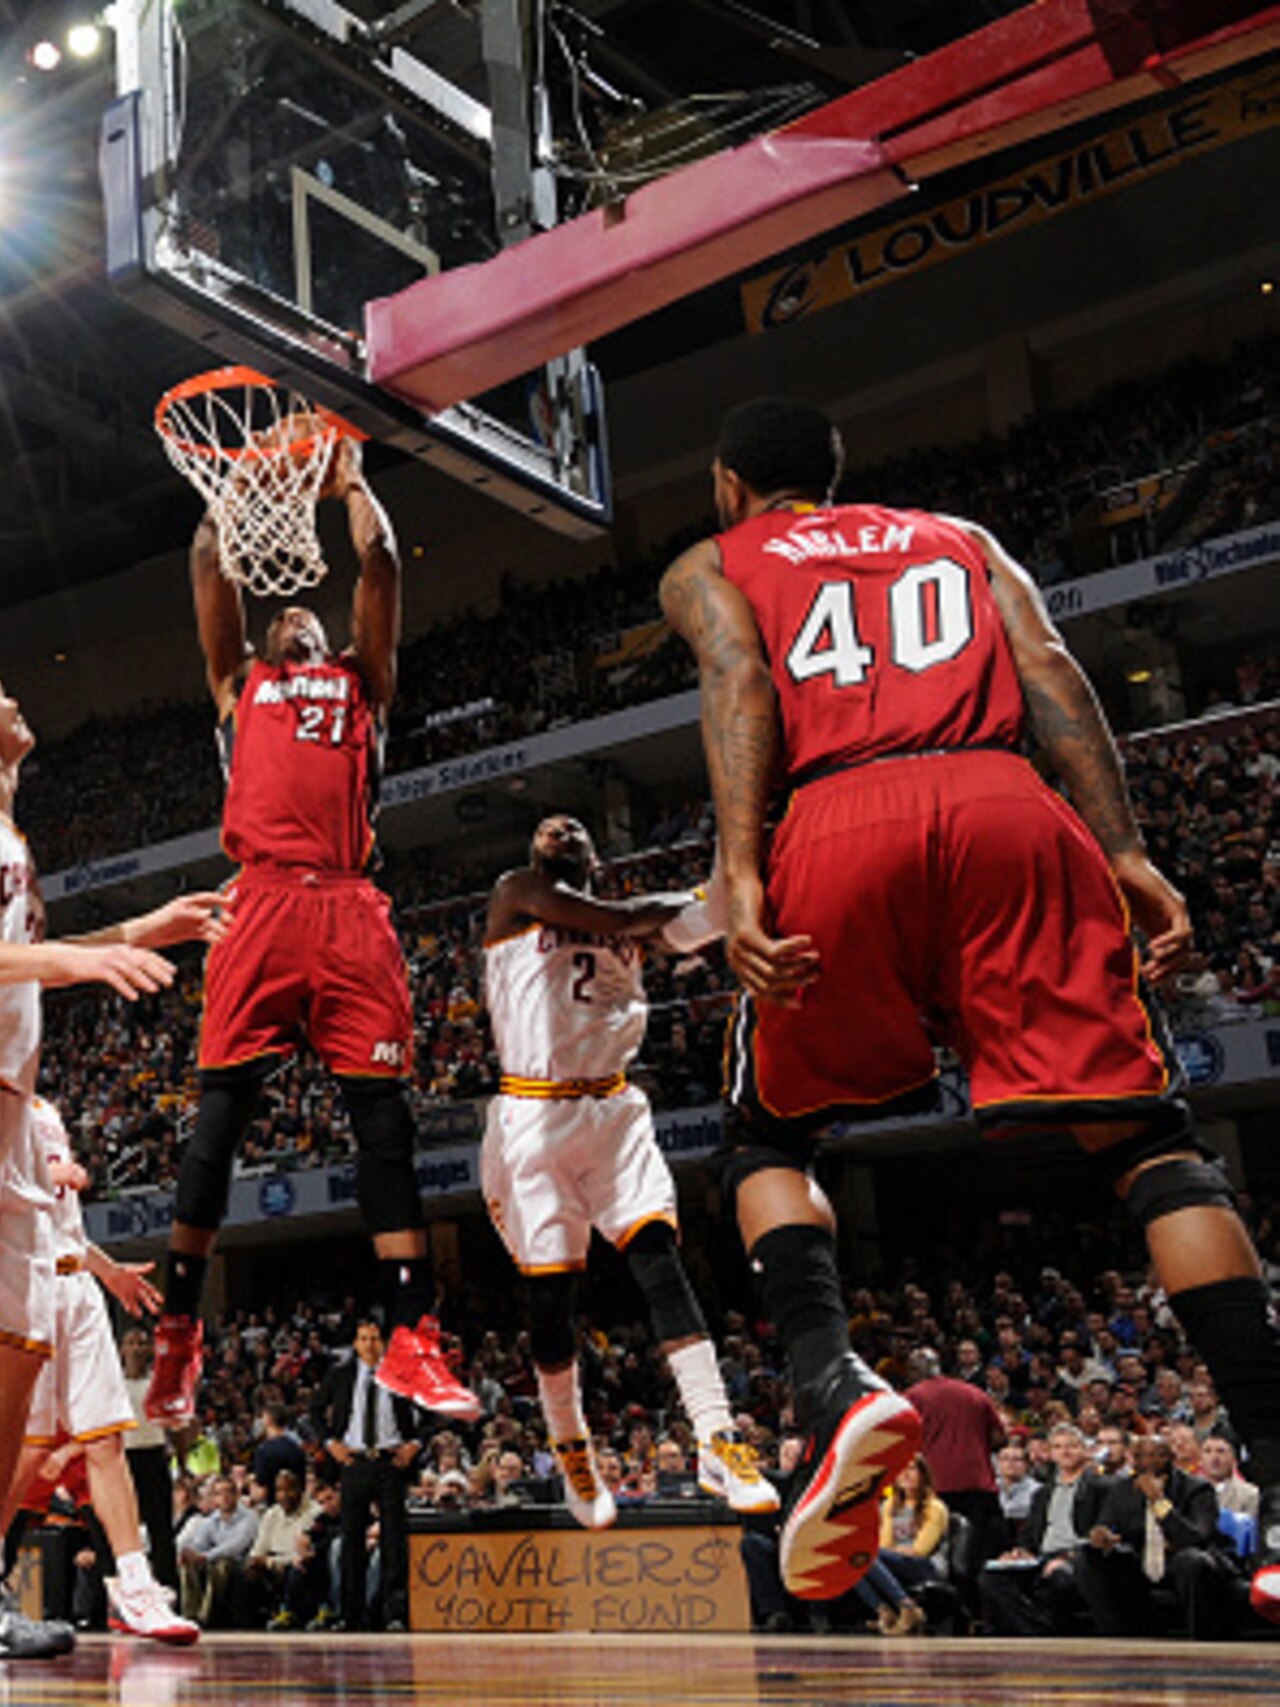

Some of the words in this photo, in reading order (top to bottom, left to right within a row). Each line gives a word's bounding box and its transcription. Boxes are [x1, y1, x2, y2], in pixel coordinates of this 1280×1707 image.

[848, 105, 1218, 287] LOUDVILLE
[786, 556, 976, 689] 40
[296, 705, 345, 743] 21
[572, 952, 596, 1004] 2
[418, 1537, 731, 1588] CAVALIERS
[433, 1594, 573, 1628] YOUTH
[591, 1594, 719, 1628] FUND
